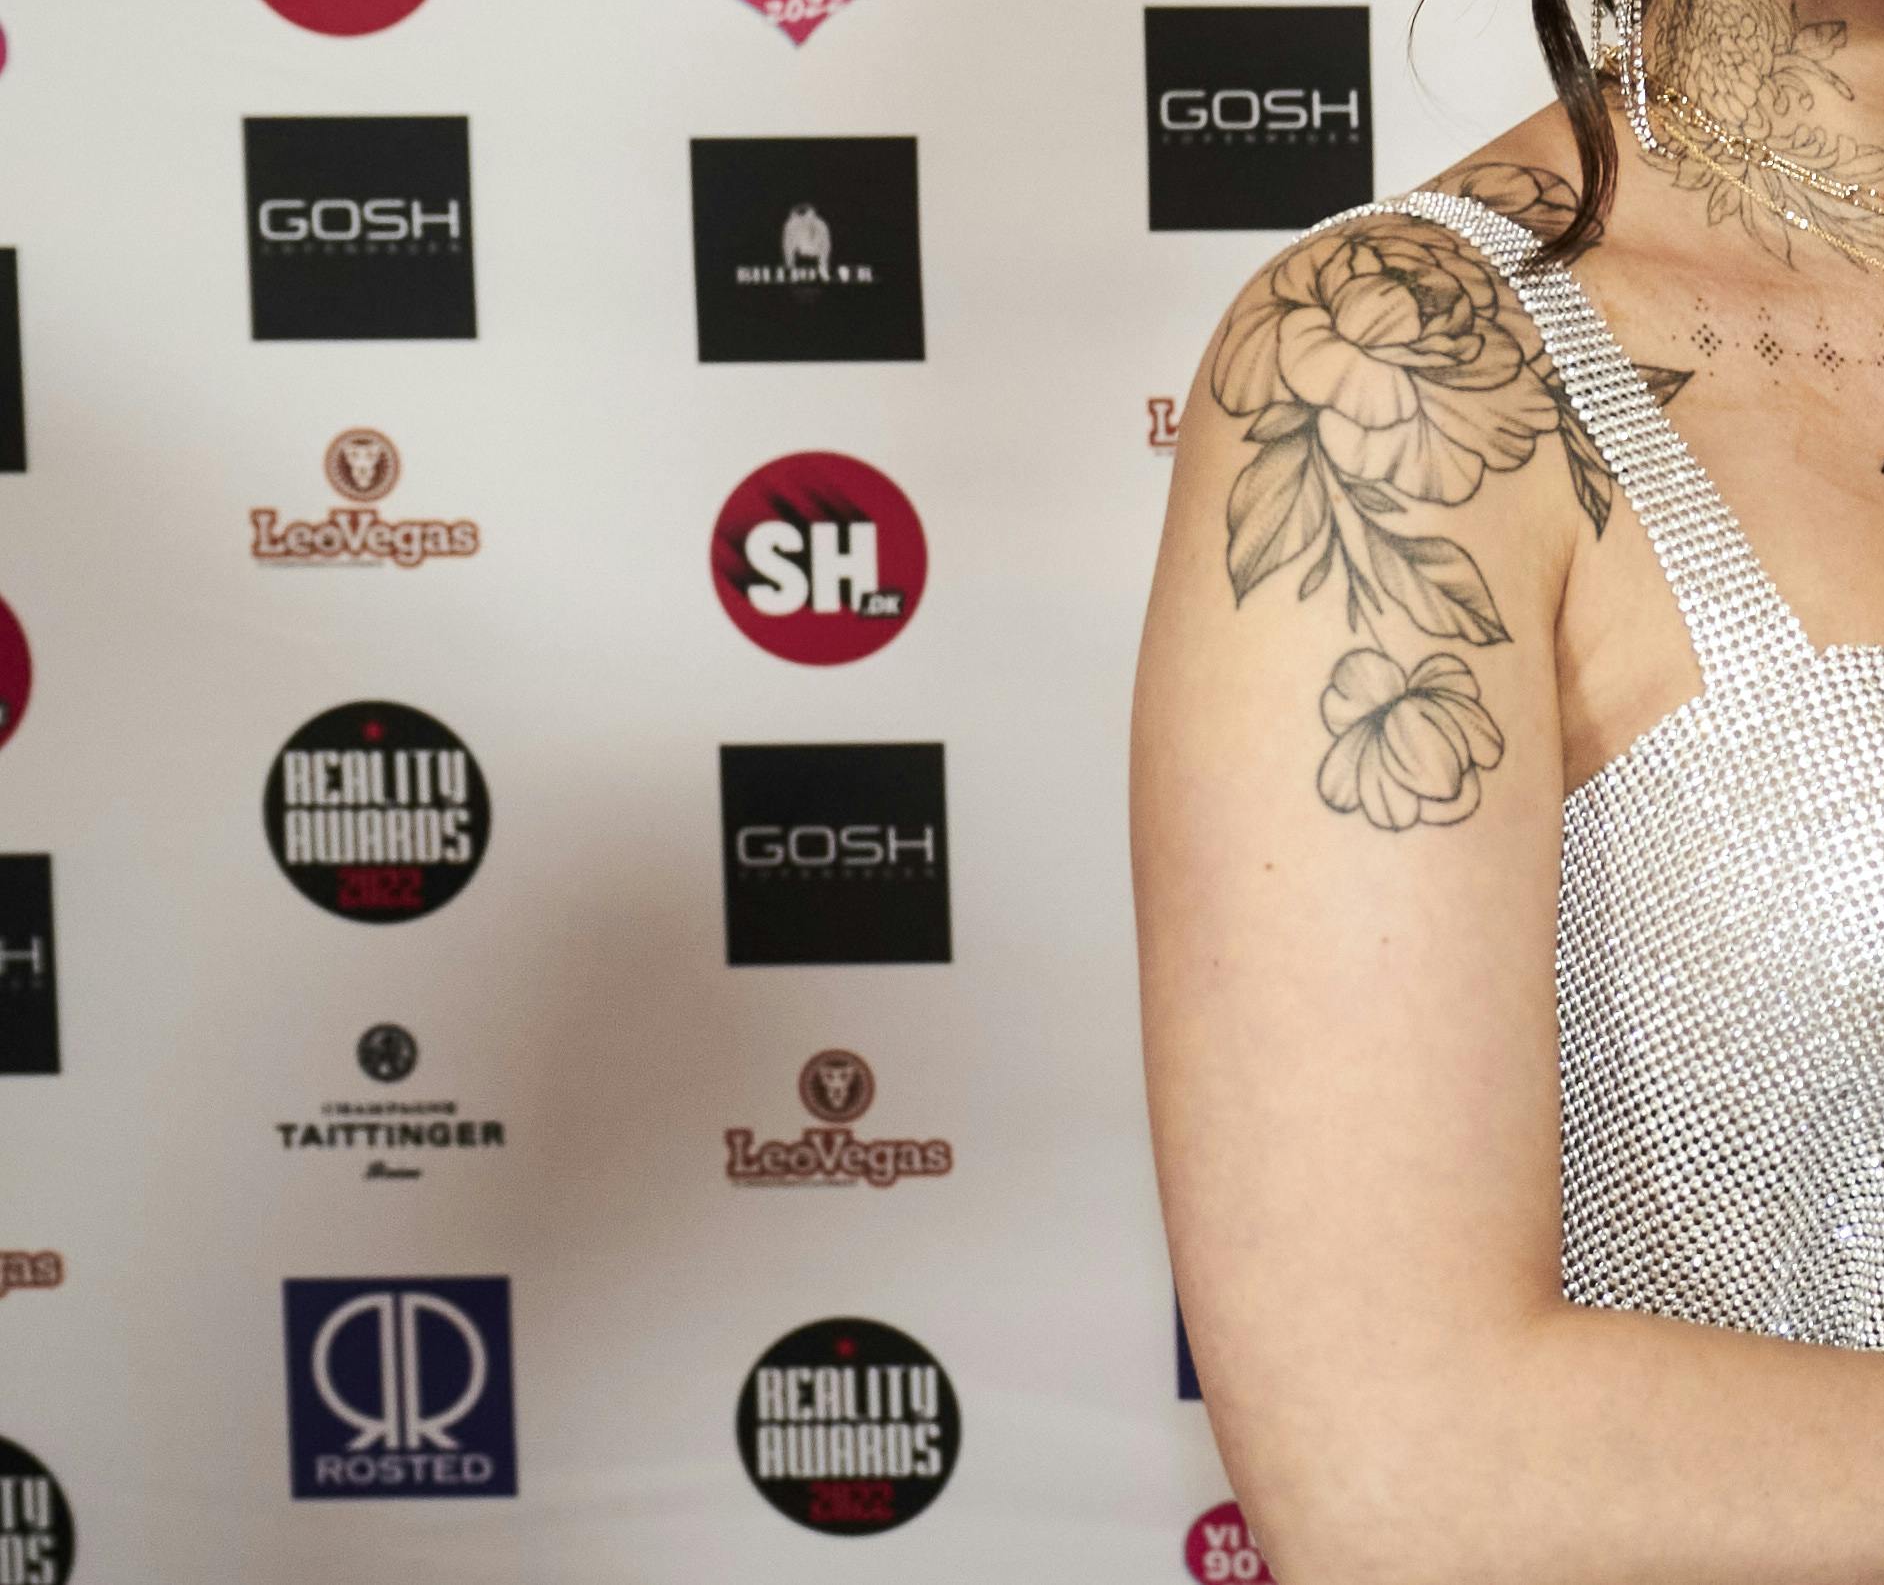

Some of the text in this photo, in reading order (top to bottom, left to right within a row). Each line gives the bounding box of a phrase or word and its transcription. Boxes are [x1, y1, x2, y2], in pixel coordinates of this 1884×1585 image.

[1160, 89, 1359, 130] GOSH
[258, 199, 460, 241] GOSH
[248, 510, 481, 569] LeoVegas
[284, 750, 470, 806] REALITY
[284, 808, 471, 863] AWARDS
[737, 825, 935, 865] GOSH
[339, 867, 422, 908] 2022
[278, 1120, 506, 1148] TAITTINGER
[727, 1129, 952, 1190] LeoVegas
[757, 1366, 940, 1421] REALITY
[316, 1453, 493, 1483] ROSTED
[757, 1423, 941, 1478] AWARDS
